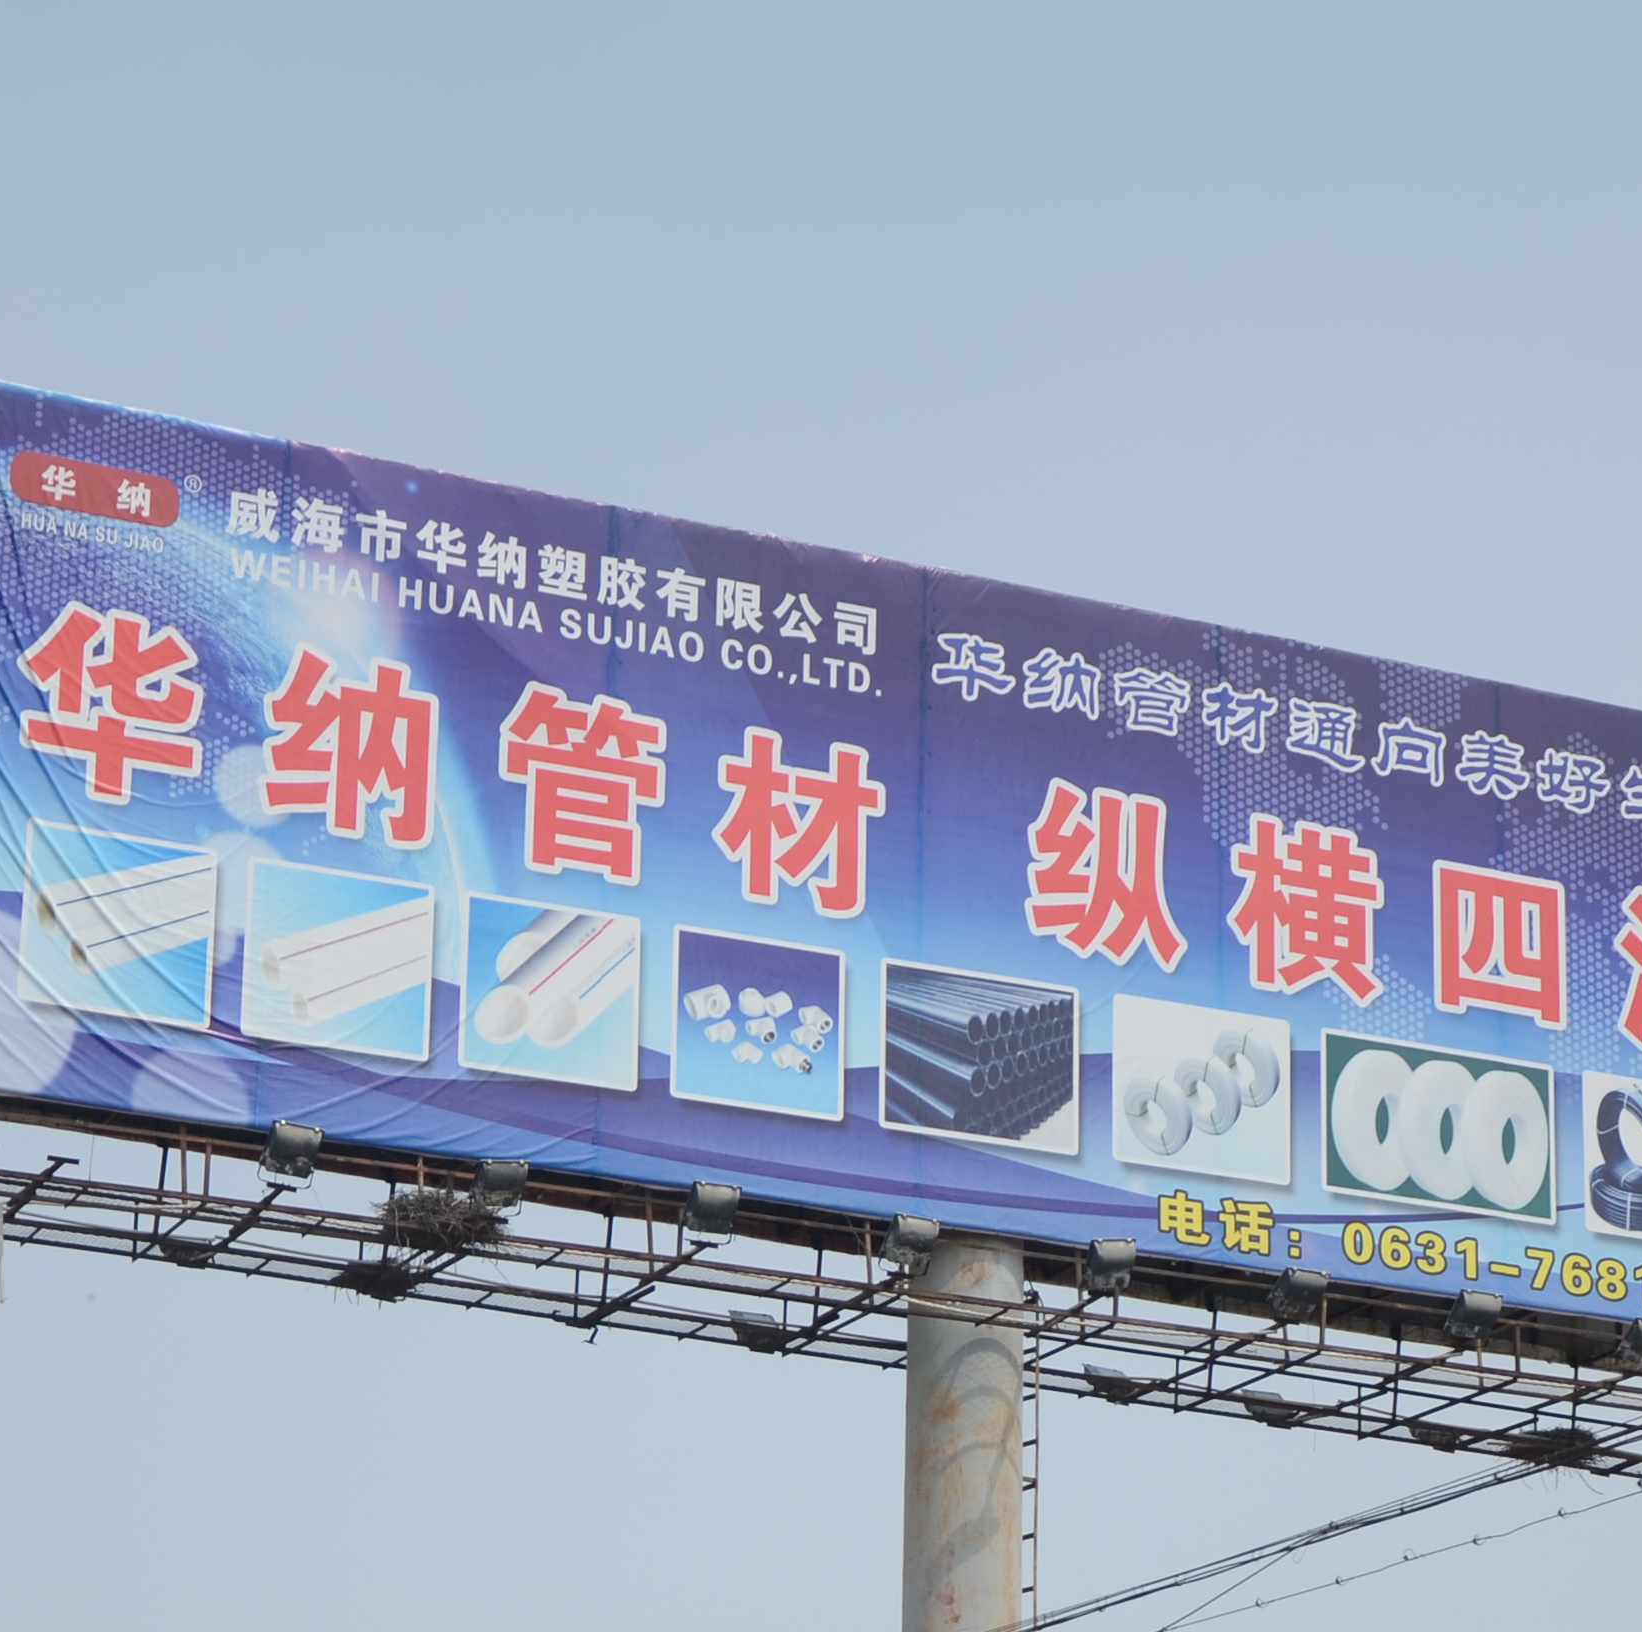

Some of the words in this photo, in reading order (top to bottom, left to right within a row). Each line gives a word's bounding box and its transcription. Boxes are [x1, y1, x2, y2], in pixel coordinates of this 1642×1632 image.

[21, 512, 57, 533] HUA
[64, 520, 88, 539] NA
[95, 526, 118, 544] SU
[125, 532, 164, 553] JIAO
[41, 465, 151, 517] 华纳
[225, 488, 877, 655] 威海市华纳塑胶有限公司
[231, 548, 379, 602] WEIHAI
[398, 576, 543, 633] HUANA
[559, 608, 704, 662] SUJIAO
[21, 604, 883, 914] 华纳管材
